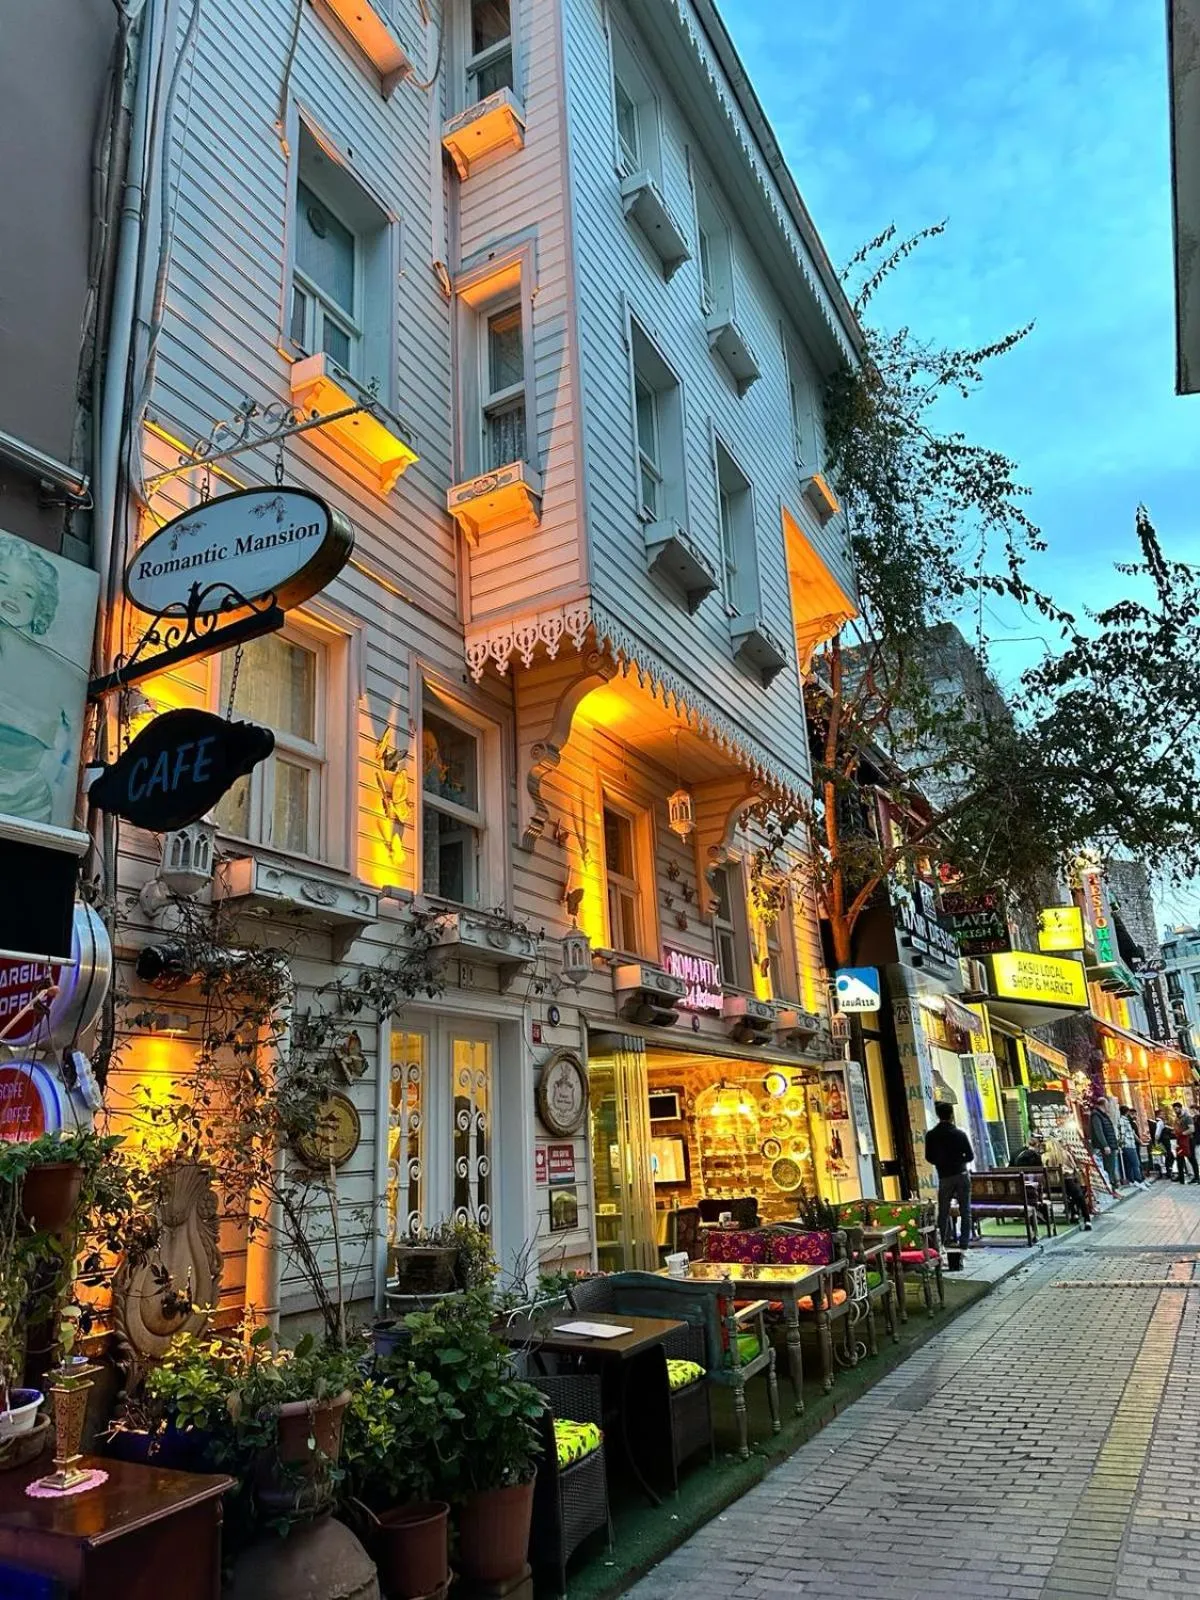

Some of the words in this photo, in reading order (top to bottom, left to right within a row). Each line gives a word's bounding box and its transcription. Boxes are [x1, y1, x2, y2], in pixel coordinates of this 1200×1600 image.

[137, 544, 228, 580] Romantic
[234, 522, 320, 556] Mansion
[127, 736, 216, 802] CAFE
[0, 962, 51, 988] ARGIL
[670, 951, 722, 988] ROMANTIC
[1018, 961, 1039, 975] AKSU
[1041, 963, 1065, 979] LOCAL
[1012, 975, 1034, 989] SHOP
[1035, 979, 1042, 991] &
[1043, 980, 1074, 996] MARKET
